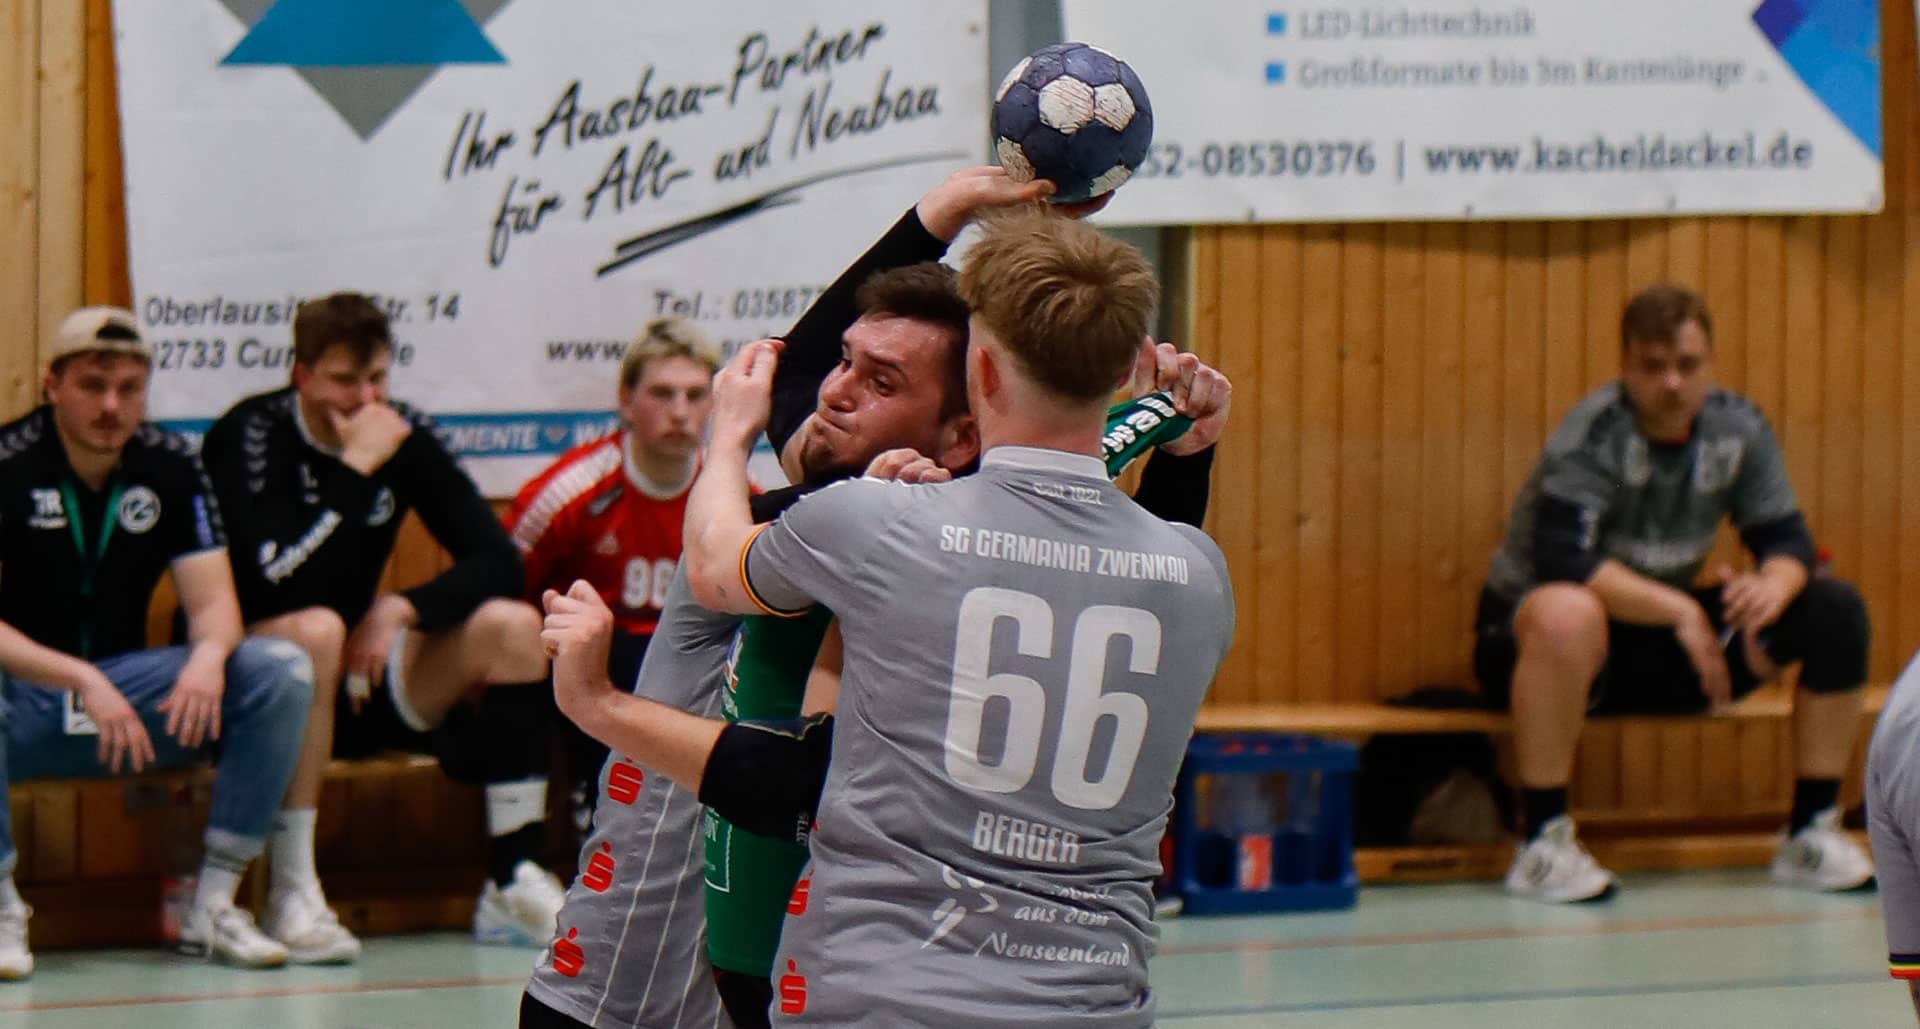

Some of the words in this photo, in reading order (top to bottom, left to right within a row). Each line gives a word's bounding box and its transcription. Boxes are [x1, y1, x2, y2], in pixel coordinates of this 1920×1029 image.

[444, 109, 516, 181] Ihr
[1424, 132, 1814, 176] www.kacheldackel.de
[427, 292, 462, 322] 14
[654, 290, 720, 321] Tel.:
[153, 338, 227, 369] 2733
[939, 524, 970, 555] SG
[975, 527, 1090, 574] GERMANIA
[1096, 547, 1189, 586] ZWENKAU
[943, 586, 1162, 811] 66
[972, 810, 1081, 864] BERGER
[1014, 905, 1057, 923] aus
[1063, 906, 1110, 927] dem
